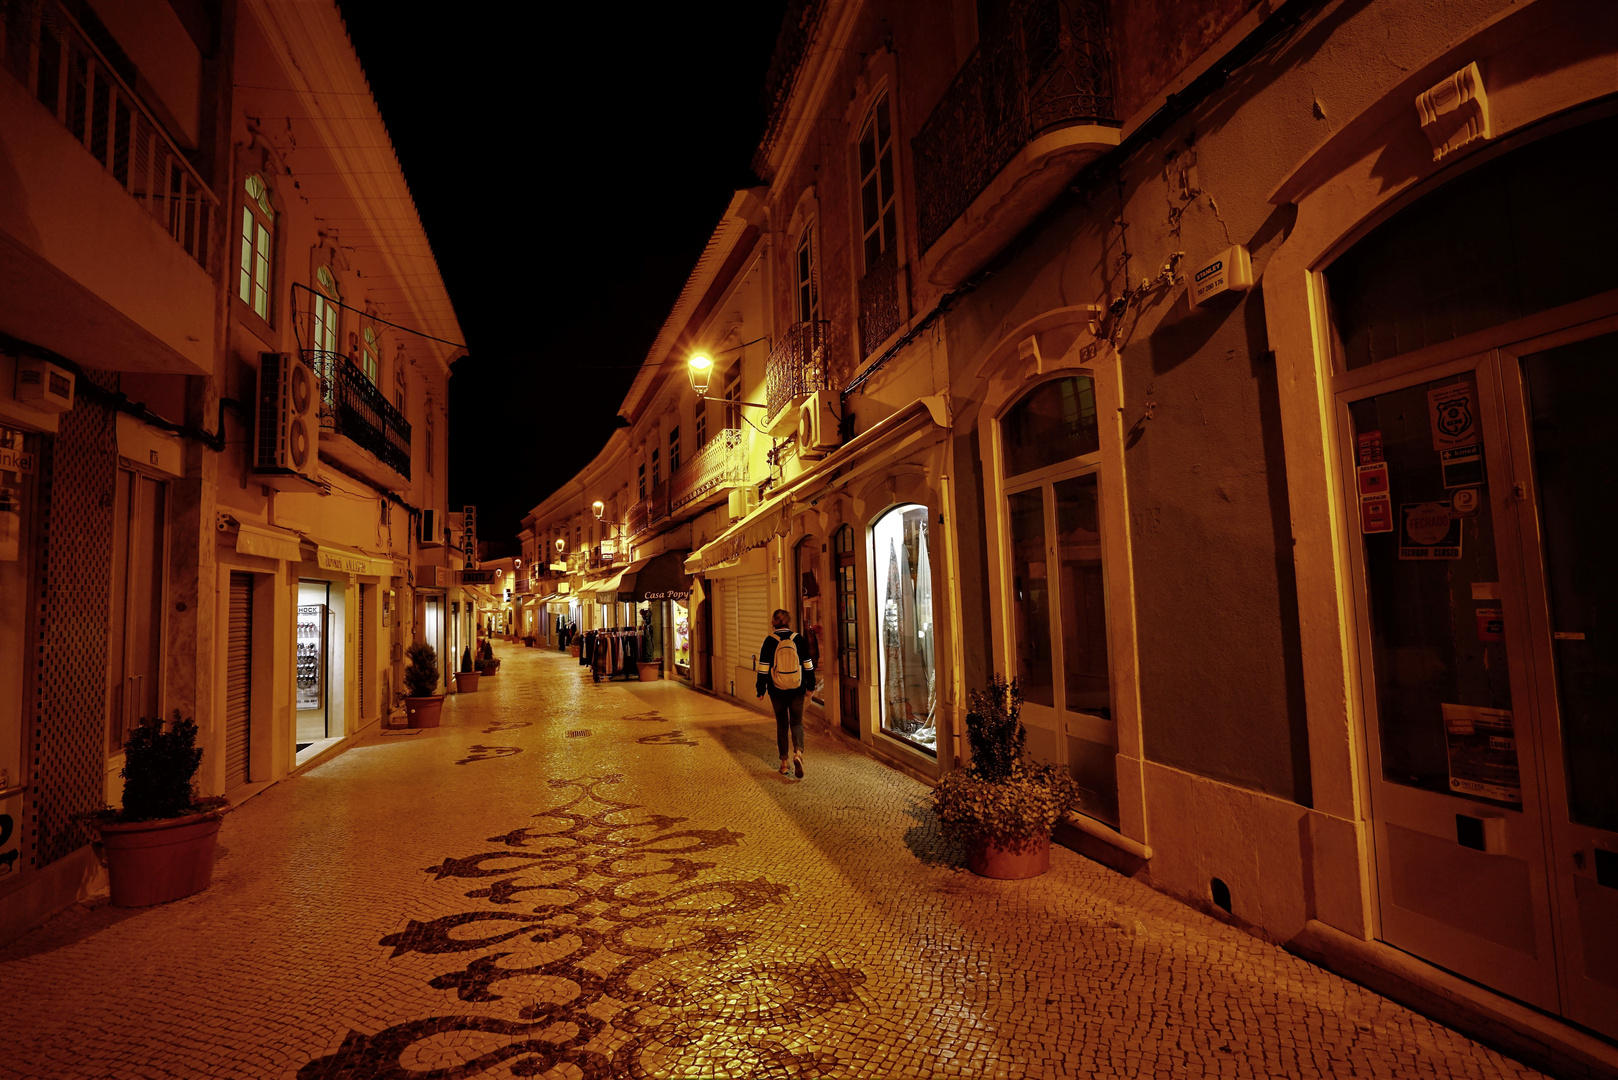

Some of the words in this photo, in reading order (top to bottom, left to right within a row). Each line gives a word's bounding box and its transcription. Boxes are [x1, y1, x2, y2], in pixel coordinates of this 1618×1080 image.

[1197, 262, 1221, 281] STANLEY
[1410, 514, 1448, 530] FECHADO
[465, 506, 474, 569] SAPATARIA
[1401, 548, 1429, 557] FECHADO
[1433, 548, 1459, 557] CLOSED
[644, 590, 665, 600] Casa
[666, 590, 690, 600] Popy
